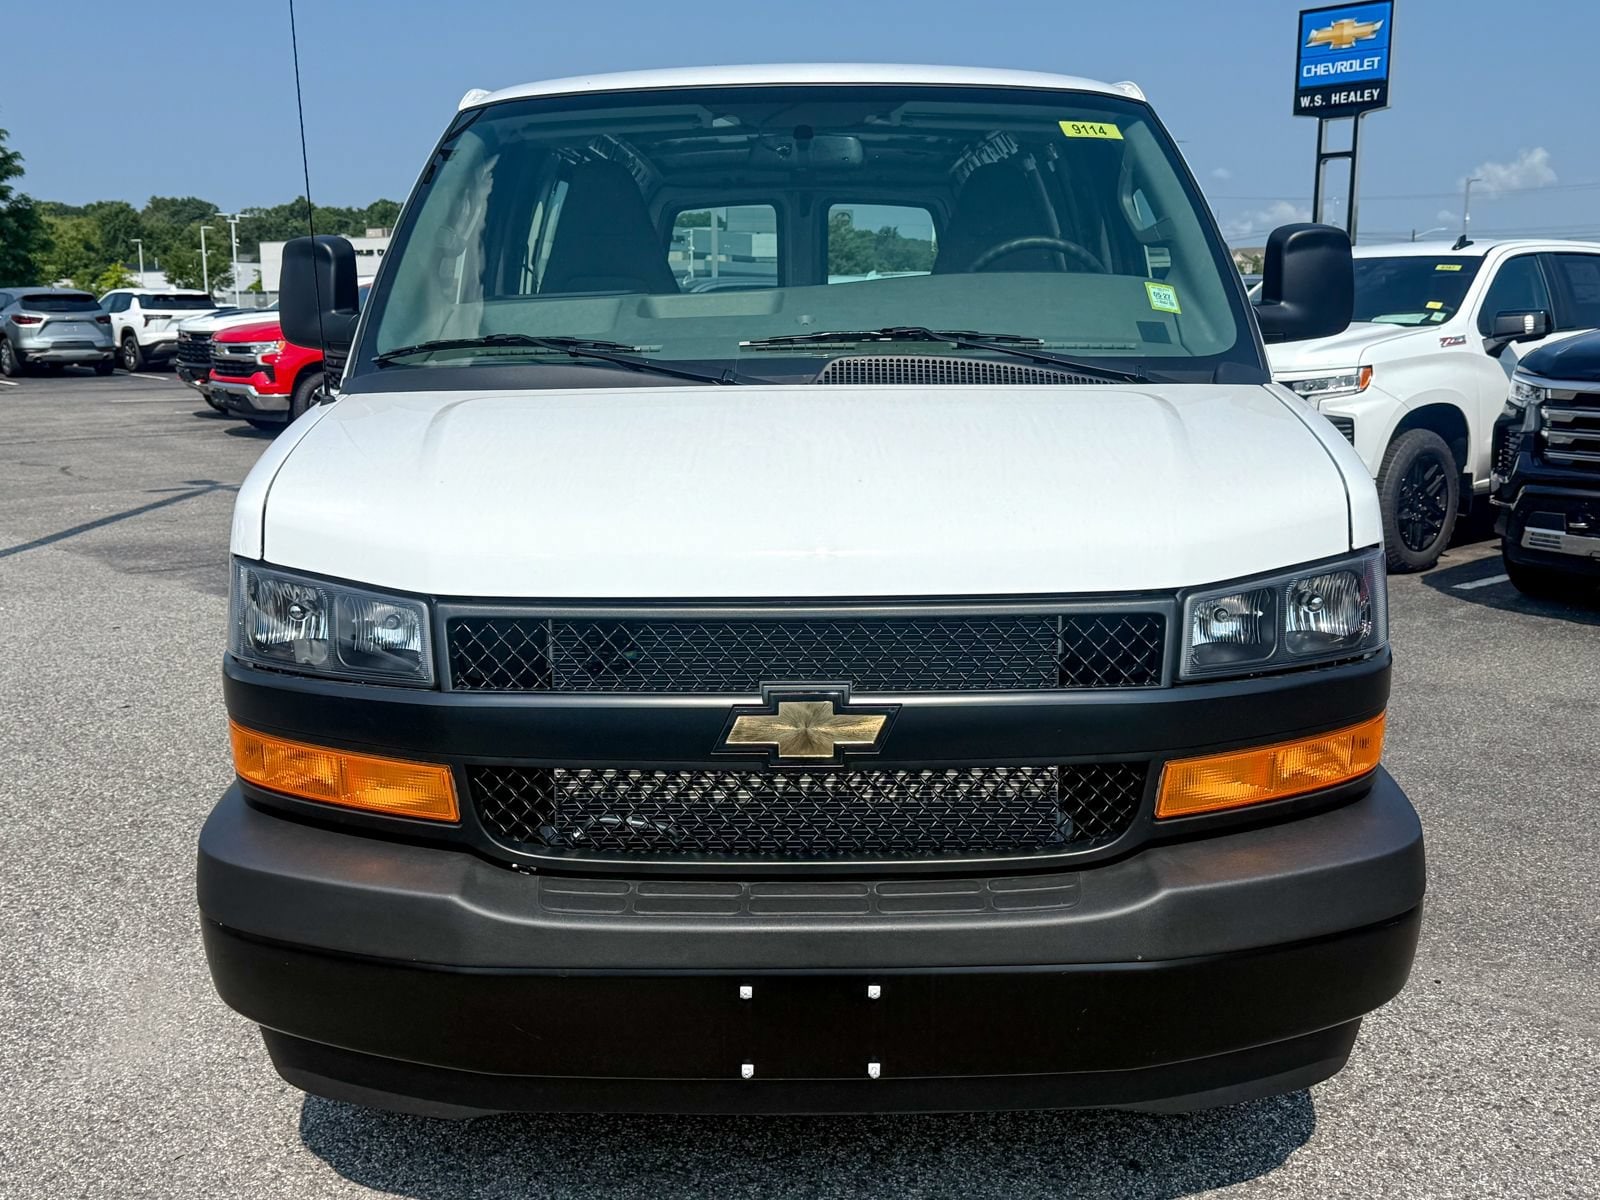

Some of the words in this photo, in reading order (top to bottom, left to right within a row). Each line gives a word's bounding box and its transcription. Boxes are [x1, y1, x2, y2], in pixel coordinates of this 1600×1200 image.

[1303, 57, 1381, 77] CHEVROLET
[1300, 95, 1326, 107] W.S.
[1331, 88, 1380, 104] HEALEY
[1072, 124, 1107, 135] 9114
